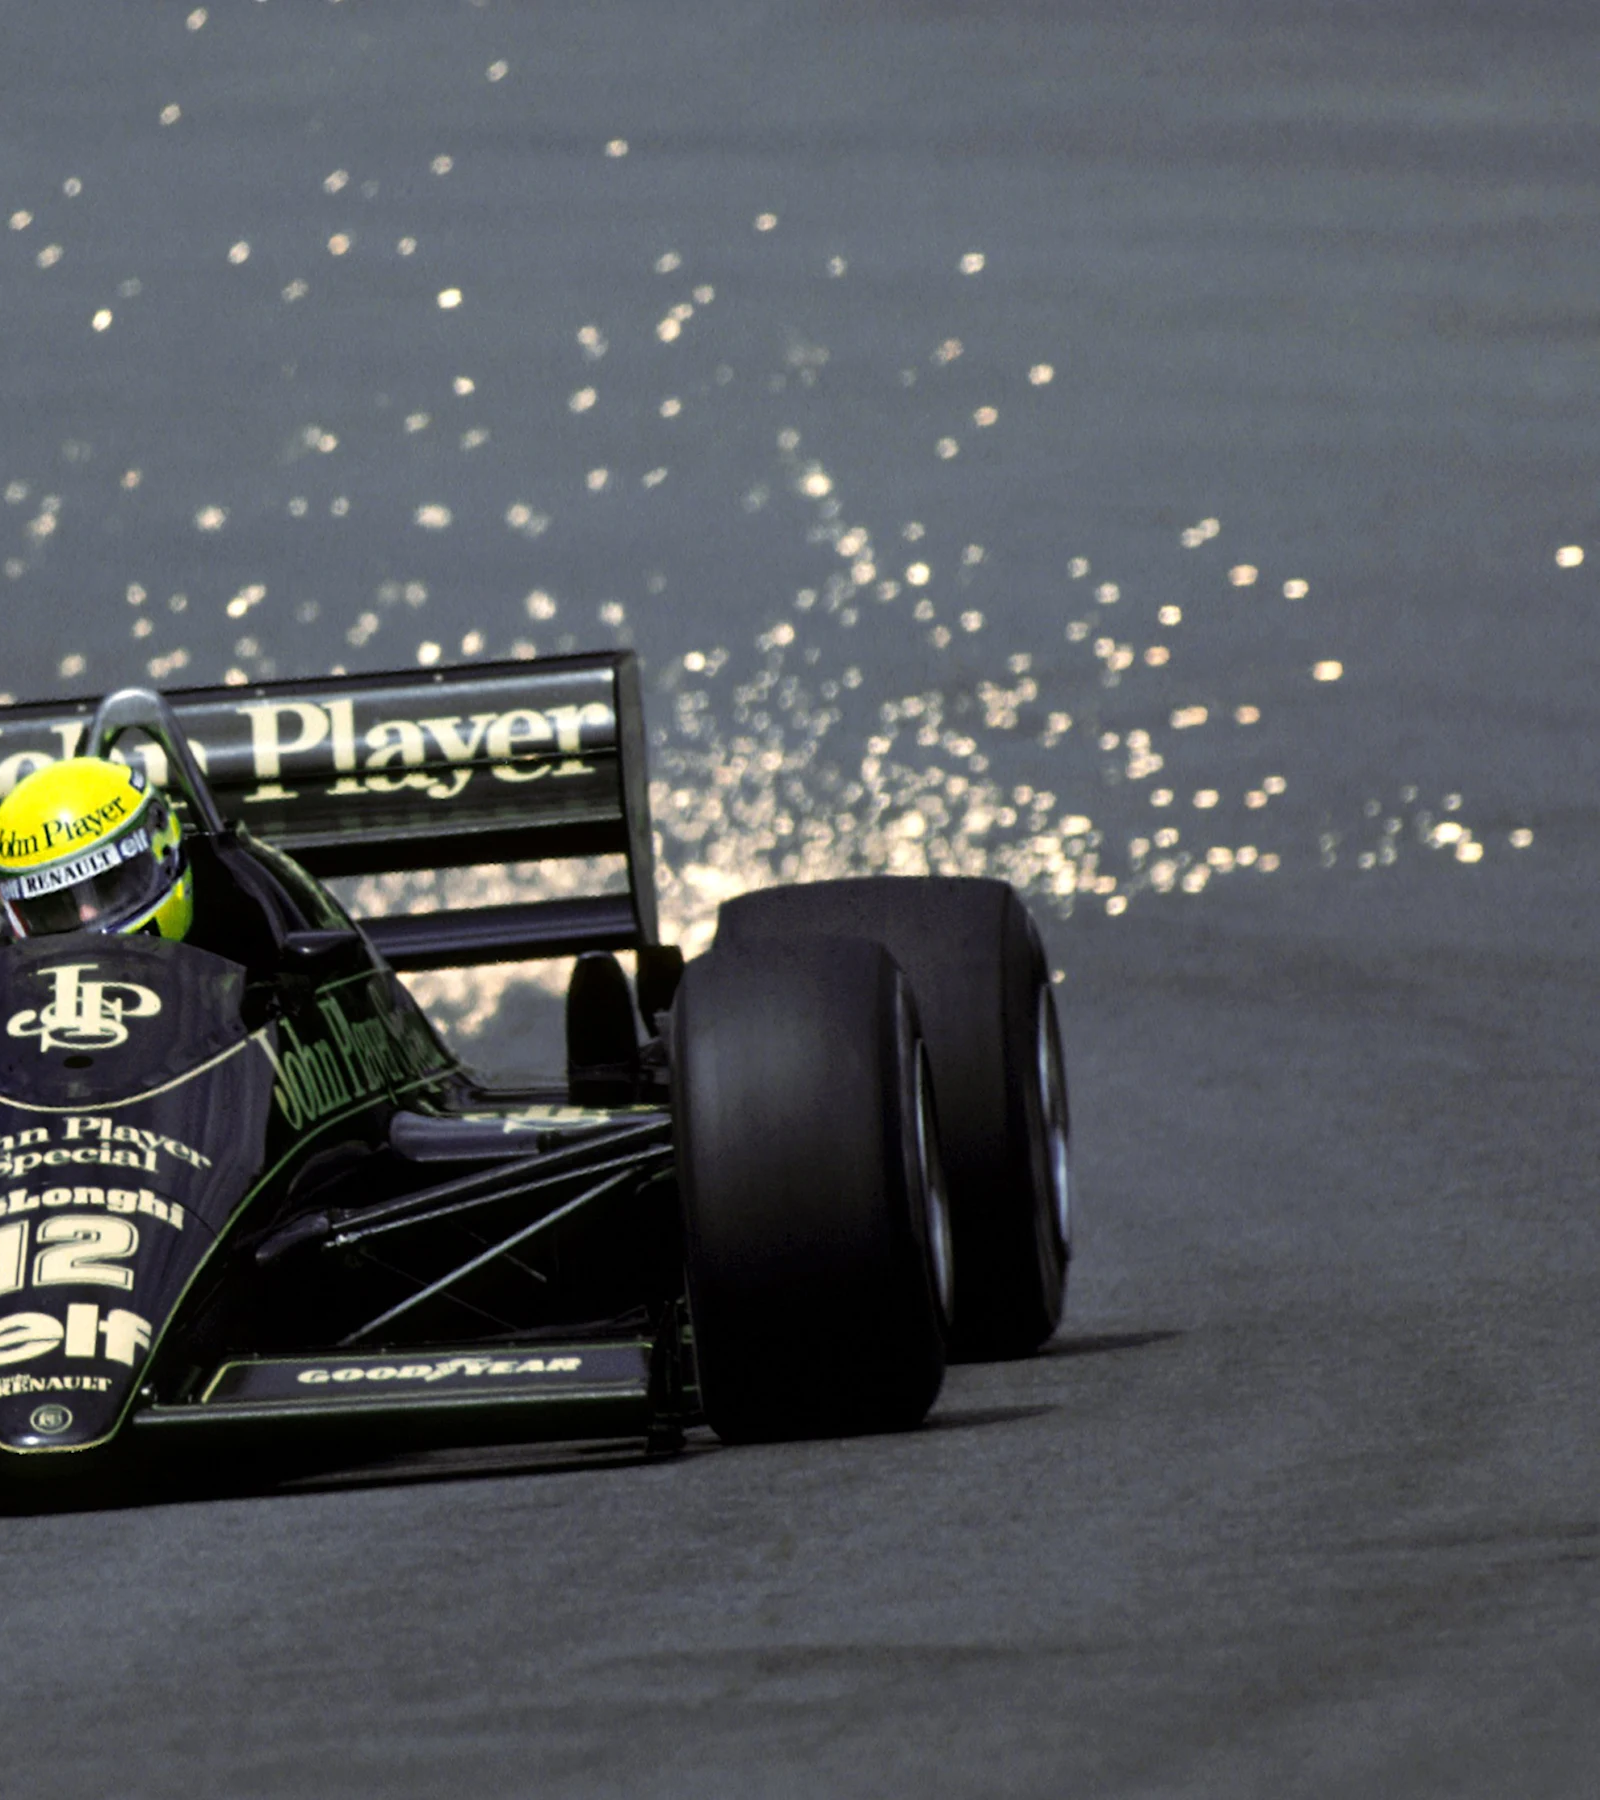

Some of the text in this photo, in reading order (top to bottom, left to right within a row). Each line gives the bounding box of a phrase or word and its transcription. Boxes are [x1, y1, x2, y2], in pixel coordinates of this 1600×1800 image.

[236, 700, 612, 801] Player
[43, 796, 128, 848] Player
[26, 852, 112, 893] RENAULT
[61, 1116, 213, 1171] Player
[296, 1357, 584, 1384] GOODYEAR
